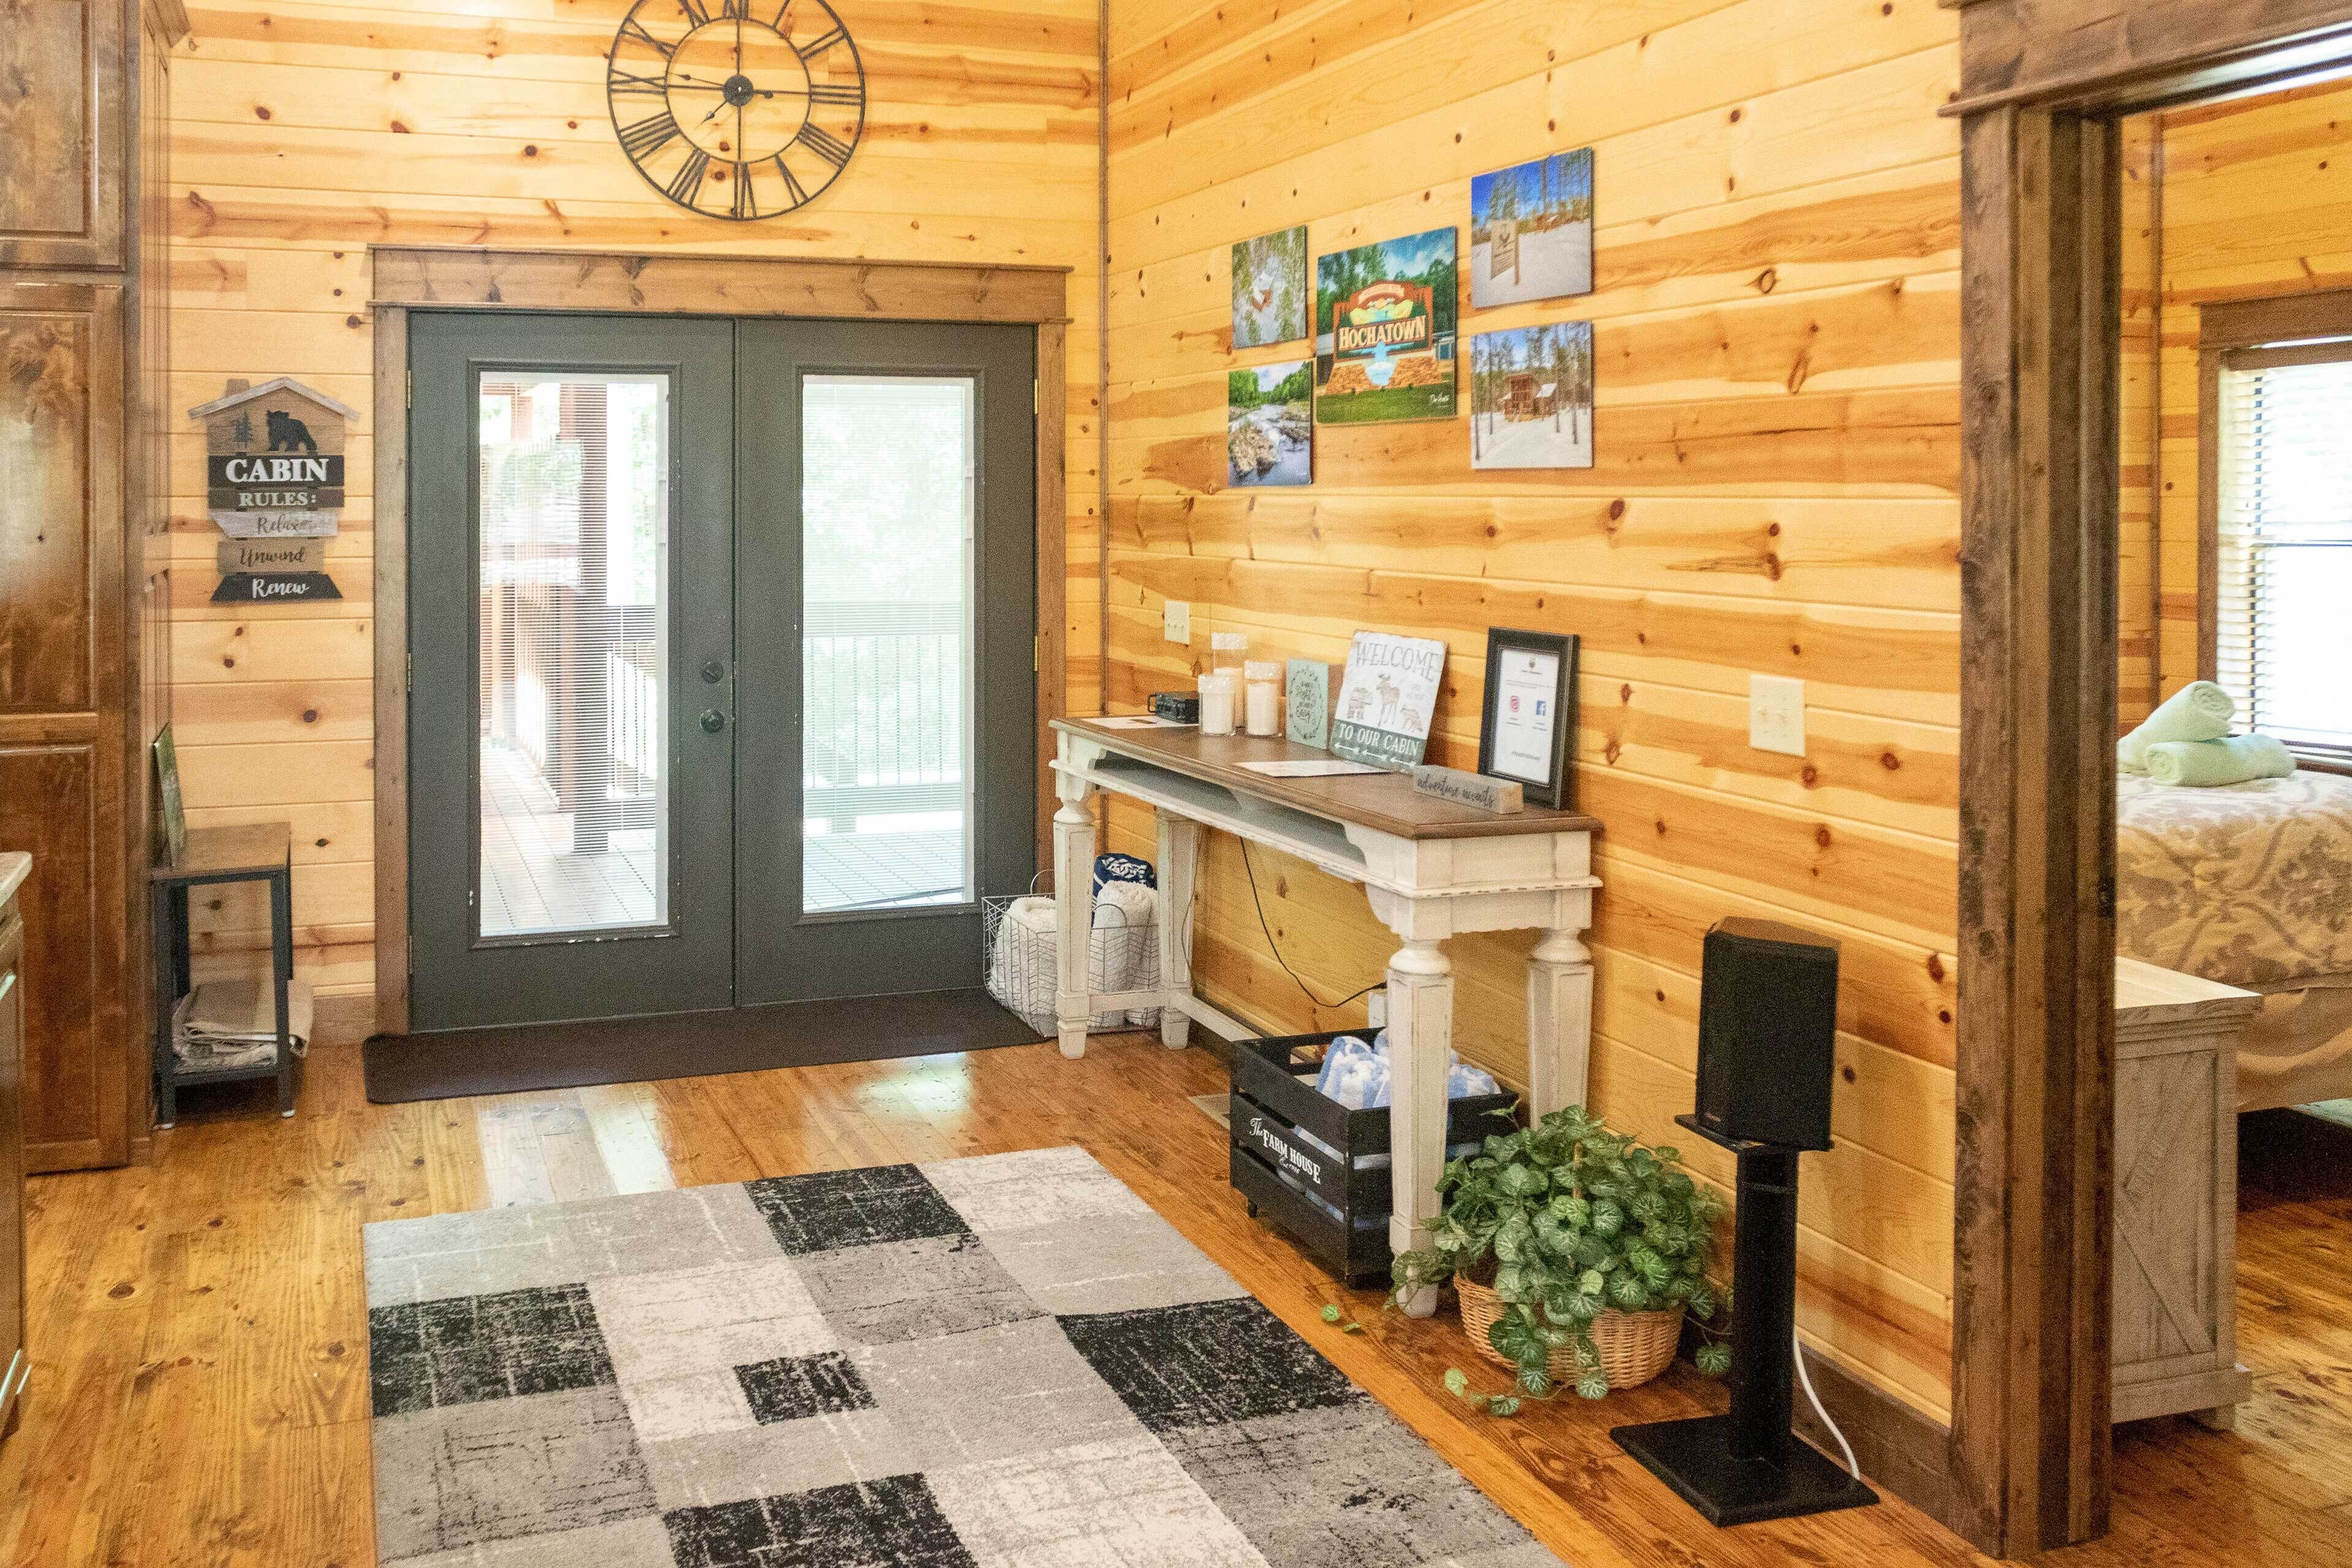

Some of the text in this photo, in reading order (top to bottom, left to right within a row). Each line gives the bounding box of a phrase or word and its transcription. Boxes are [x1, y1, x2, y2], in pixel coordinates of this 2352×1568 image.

[1338, 315, 1427, 350] HOCHATOWN
[225, 458, 330, 483] CABIN
[238, 492, 317, 507] RULES:
[257, 513, 300, 535] Relax
[238, 548, 306, 567] Unwind
[252, 578, 309, 599] Renew
[1355, 641, 1439, 682] WELCOME
[1339, 724, 1420, 756] TO OUR CABIN
[1249, 1118, 1321, 1185] The FARM HOUSE
